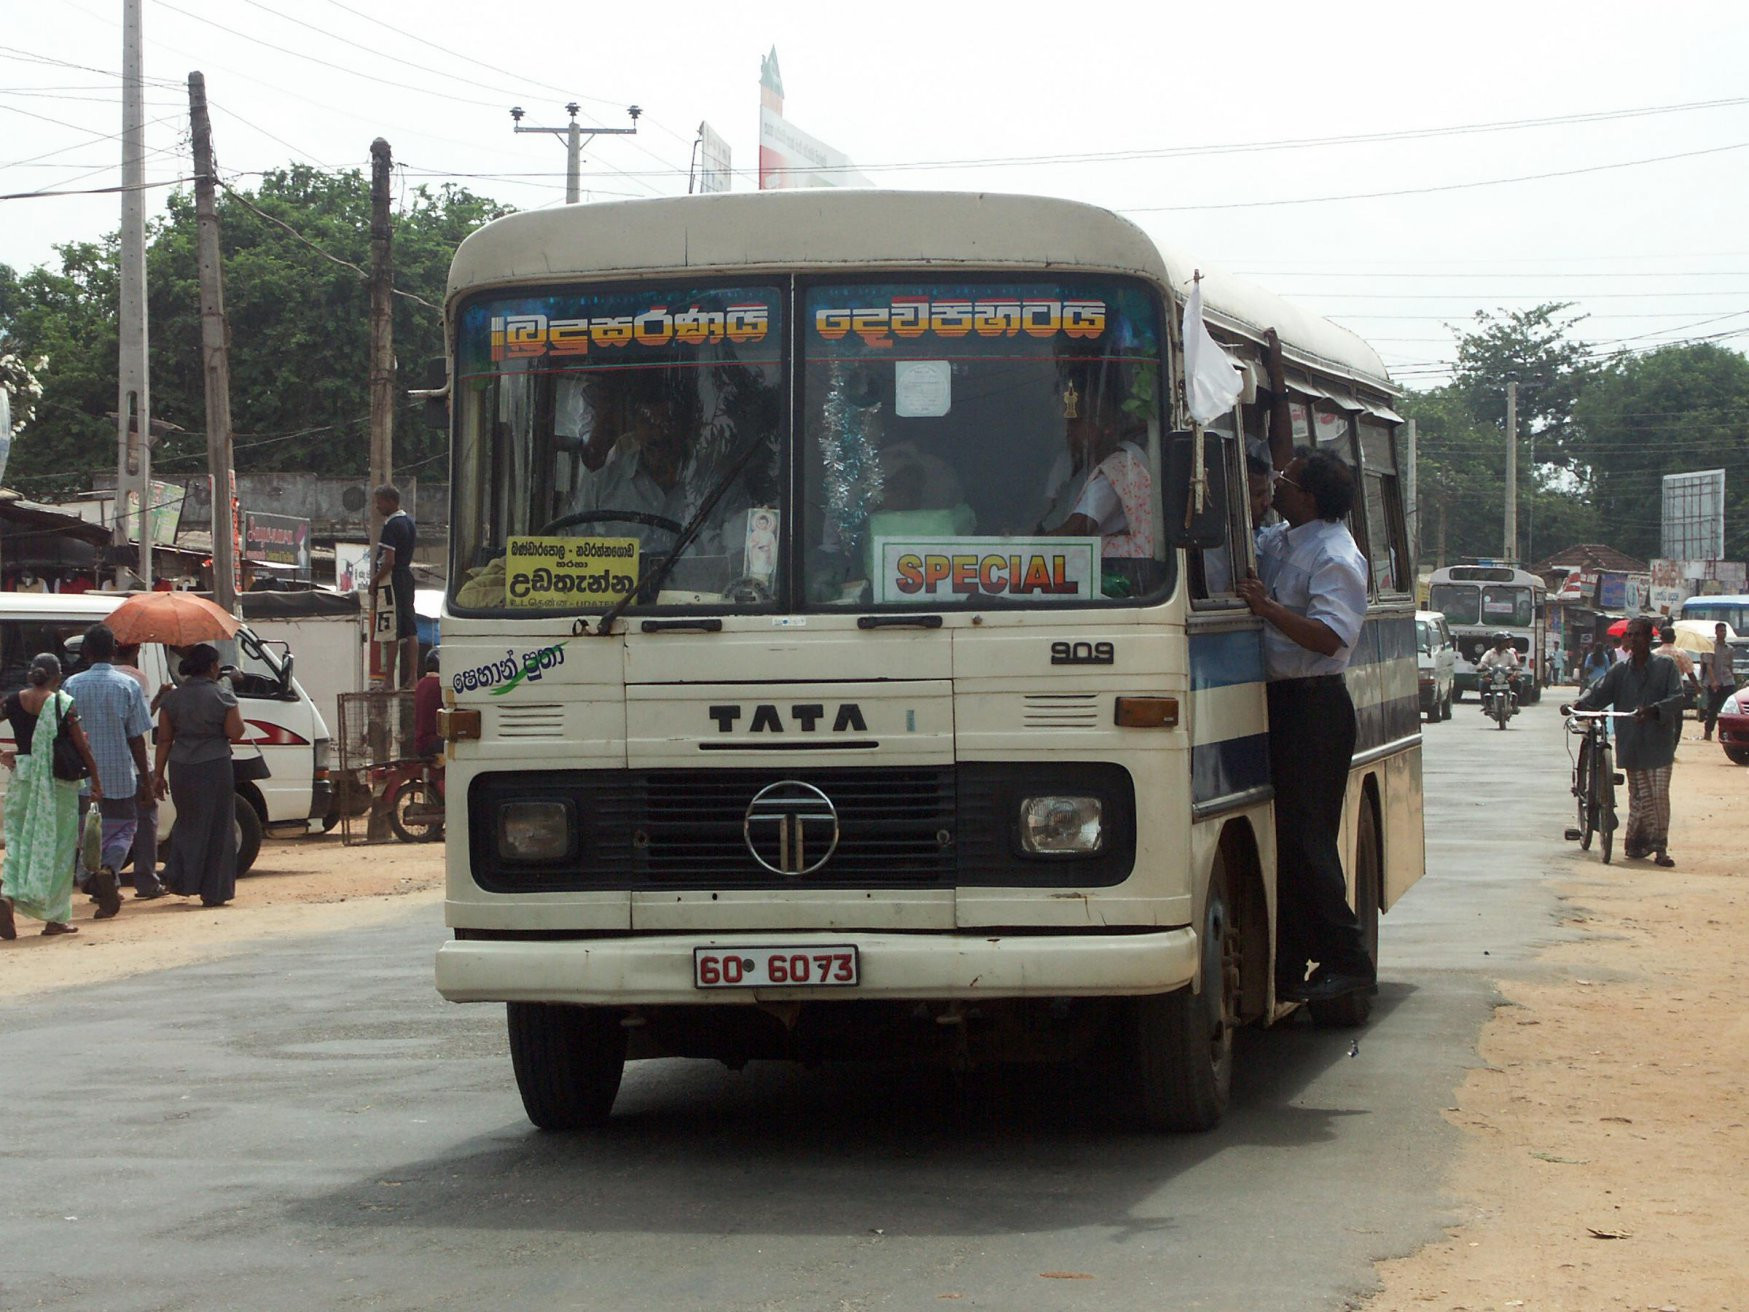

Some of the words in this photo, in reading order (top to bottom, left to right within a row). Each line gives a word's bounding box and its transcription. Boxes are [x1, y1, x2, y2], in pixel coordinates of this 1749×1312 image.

[895, 554, 1079, 594] SPECIAL
[1051, 642, 1114, 664] 909
[709, 703, 868, 733] TATA
[700, 955, 743, 984] 60
[767, 954, 853, 982] 6073
